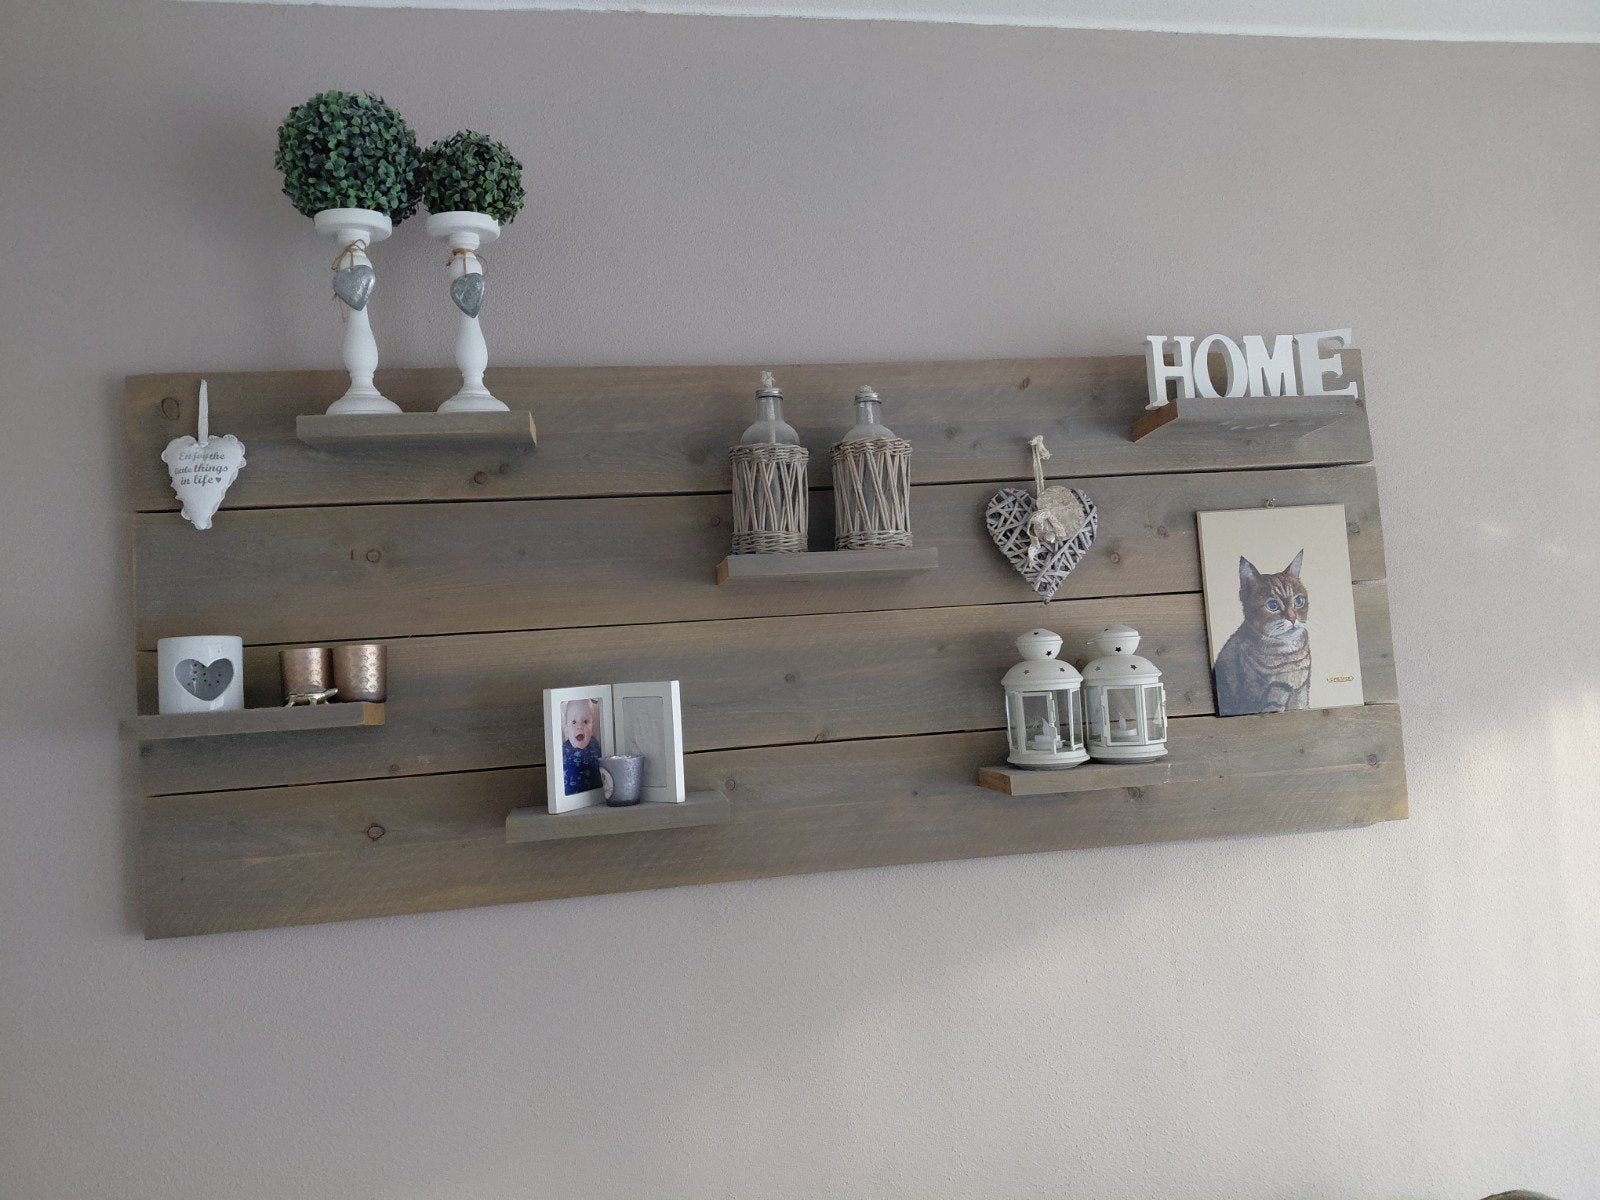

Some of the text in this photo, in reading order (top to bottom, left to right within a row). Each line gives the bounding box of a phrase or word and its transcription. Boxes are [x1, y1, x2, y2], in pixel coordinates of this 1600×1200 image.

[1145, 328, 1359, 410] HOME
[178, 451, 225, 461] Enjoy the
[194, 464, 229, 475] things
[180, 474, 214, 487] in life
